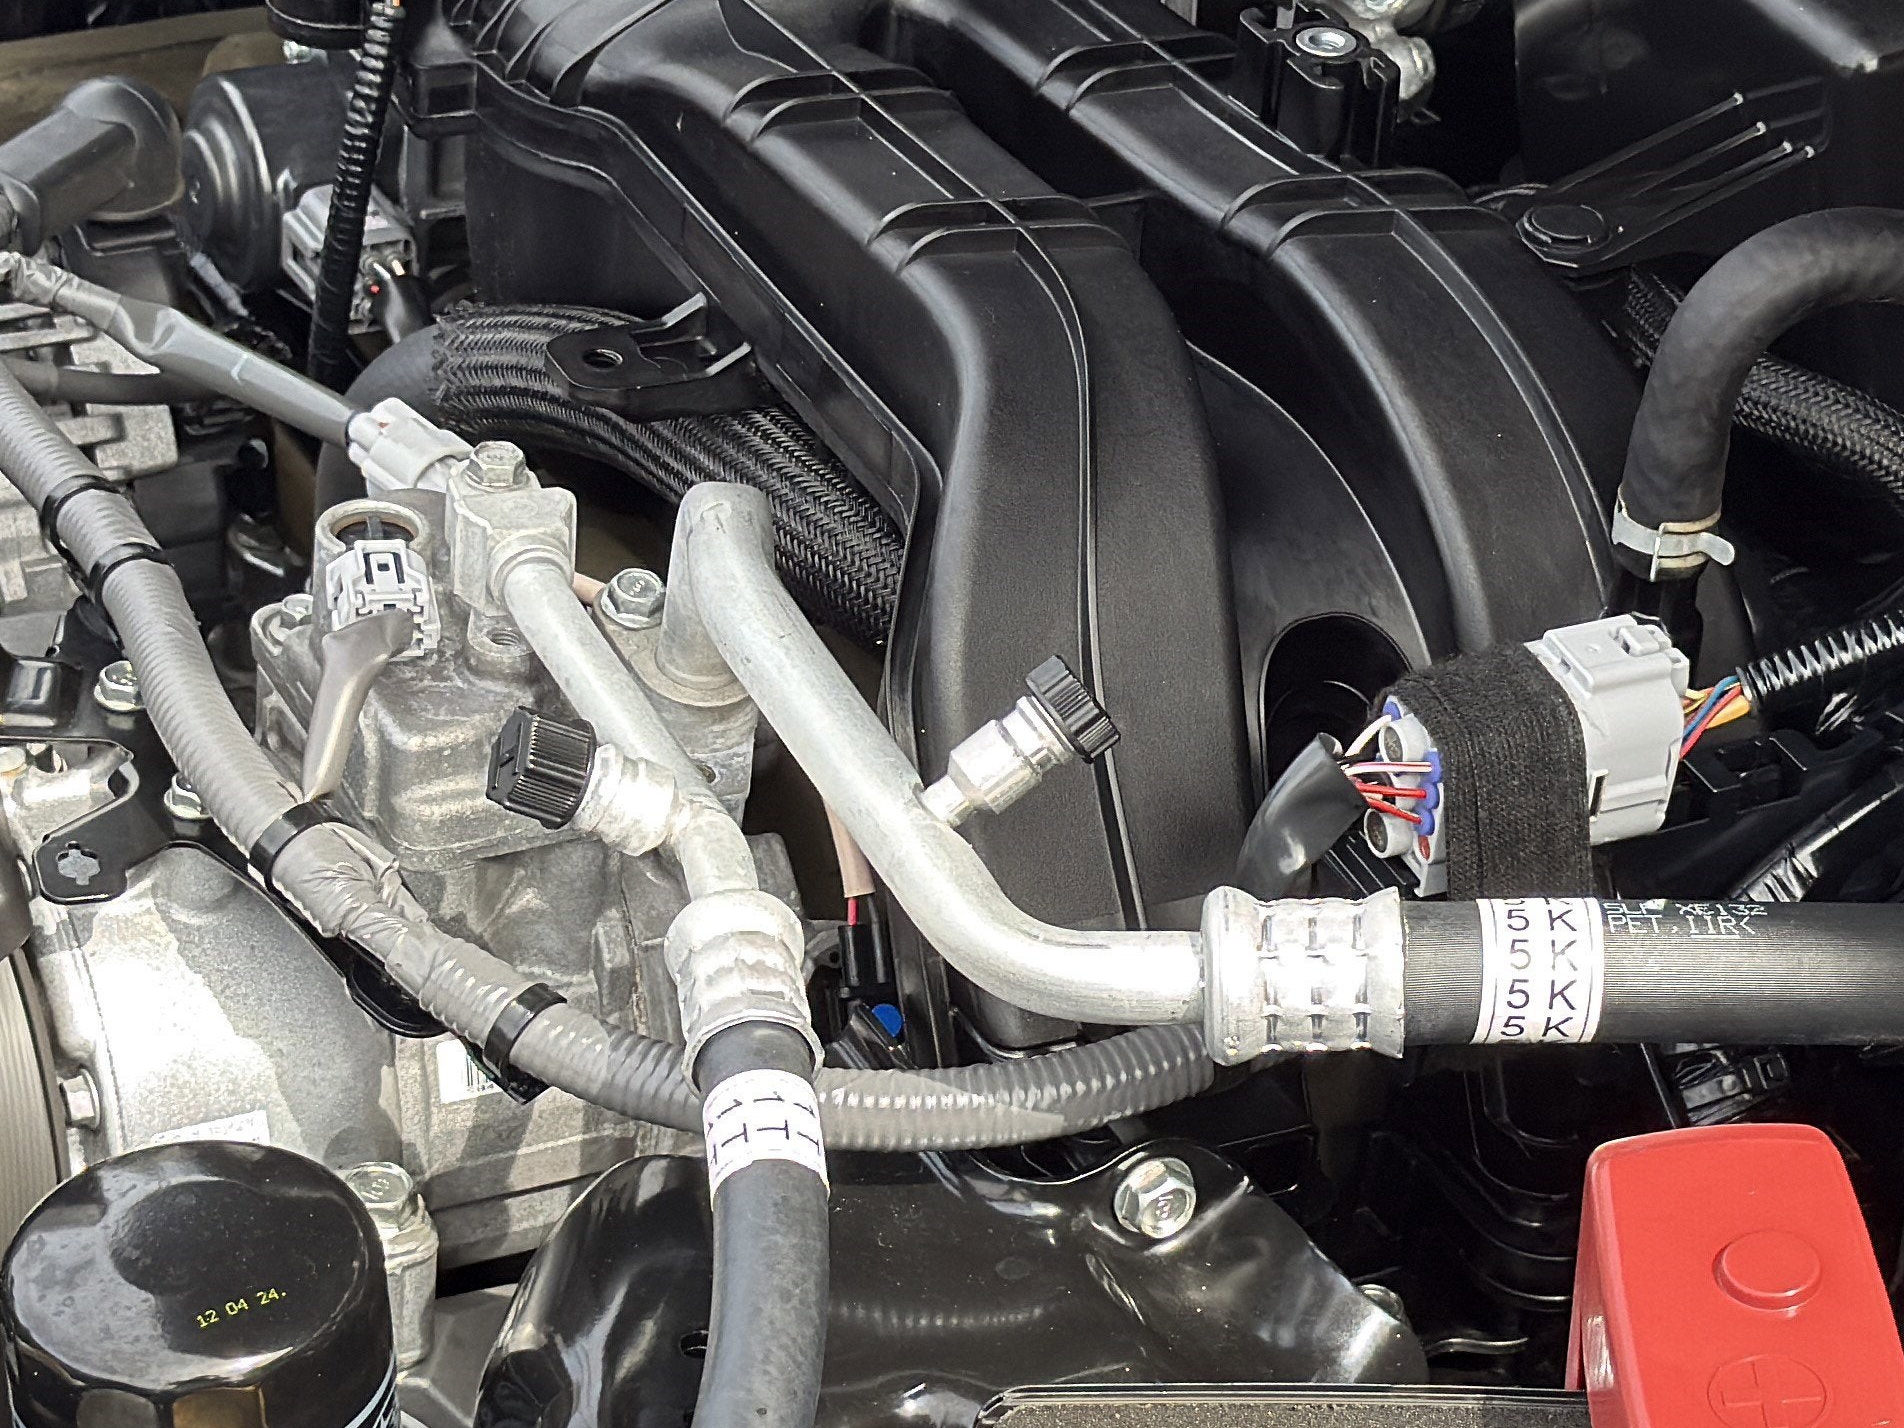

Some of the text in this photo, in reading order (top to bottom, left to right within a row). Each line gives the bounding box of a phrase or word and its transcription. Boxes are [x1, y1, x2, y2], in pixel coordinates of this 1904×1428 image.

[1505, 910, 1577, 931] 5 K
[1510, 939, 1587, 969] 5 K
[1505, 981, 1577, 1010] 5 K
[1500, 1015, 1569, 1039] 5 K
[196, 1308, 220, 1328] 12
[226, 1297, 250, 1317] 04
